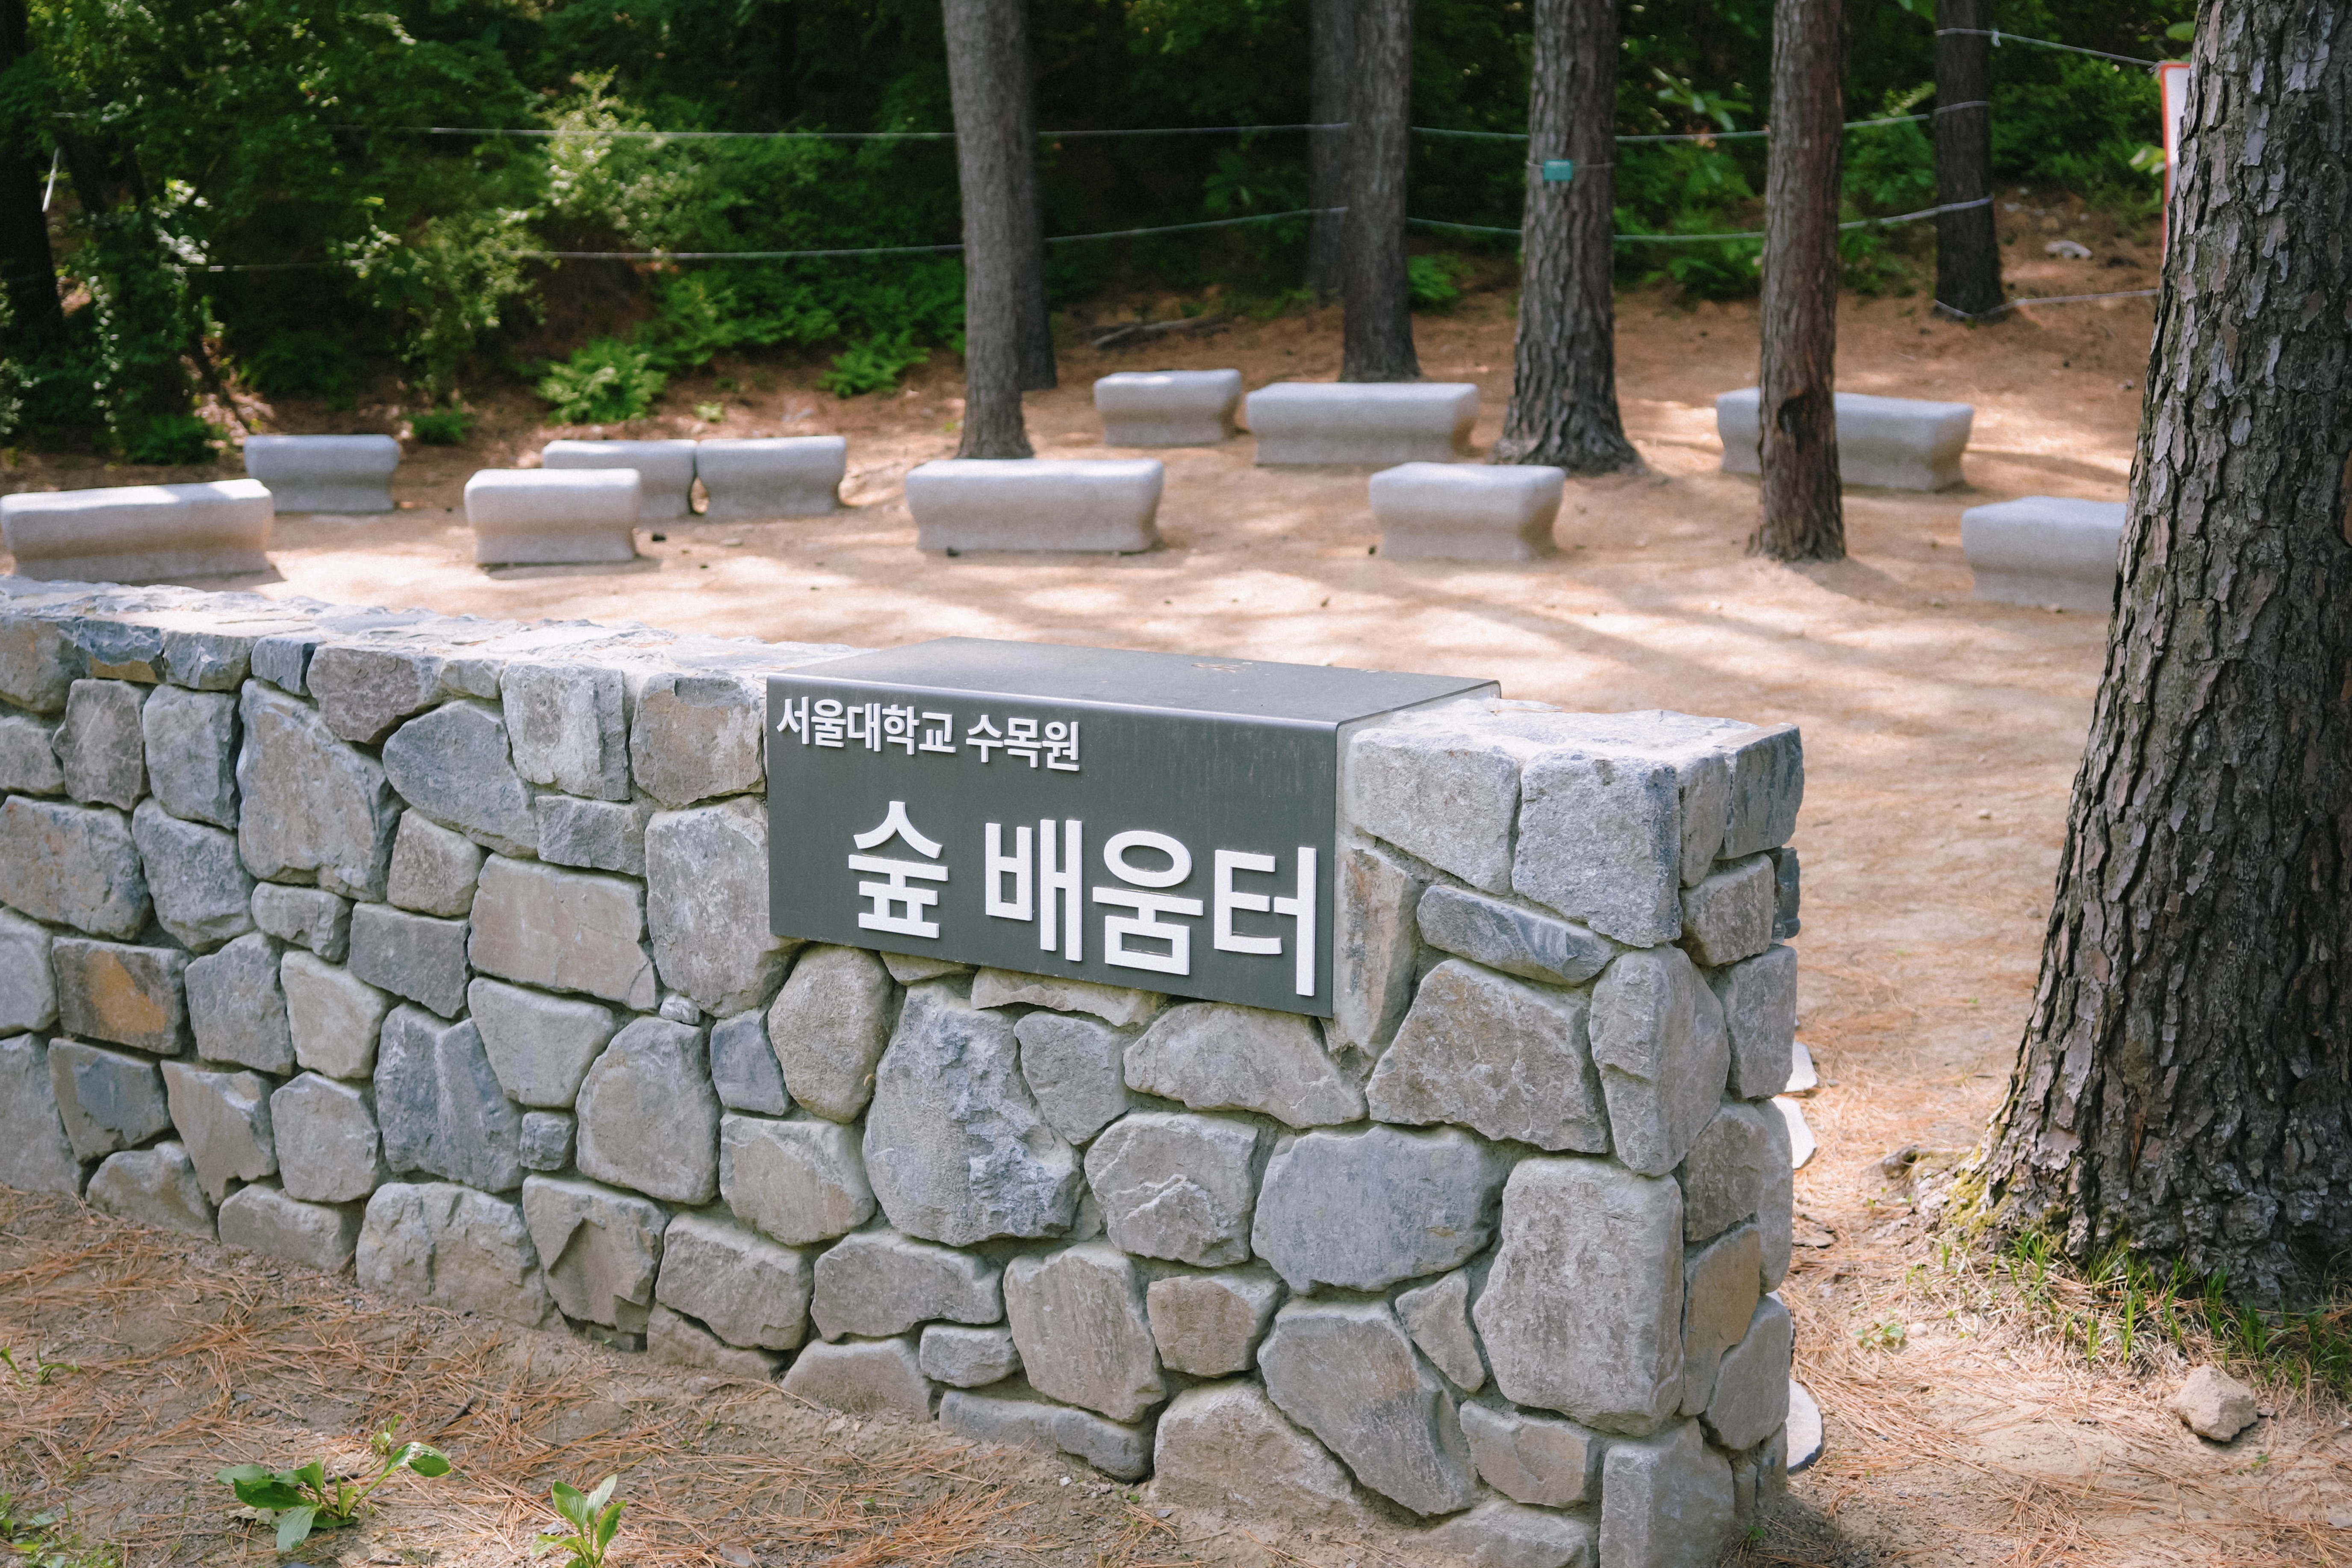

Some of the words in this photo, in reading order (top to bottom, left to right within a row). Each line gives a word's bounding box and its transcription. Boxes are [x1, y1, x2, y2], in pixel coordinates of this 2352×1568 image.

[776, 696, 956, 755] 서울대학교
[966, 714, 1080, 772] 수목원
[848, 800, 949, 939] 숲
[985, 819, 1316, 996] 배움터
